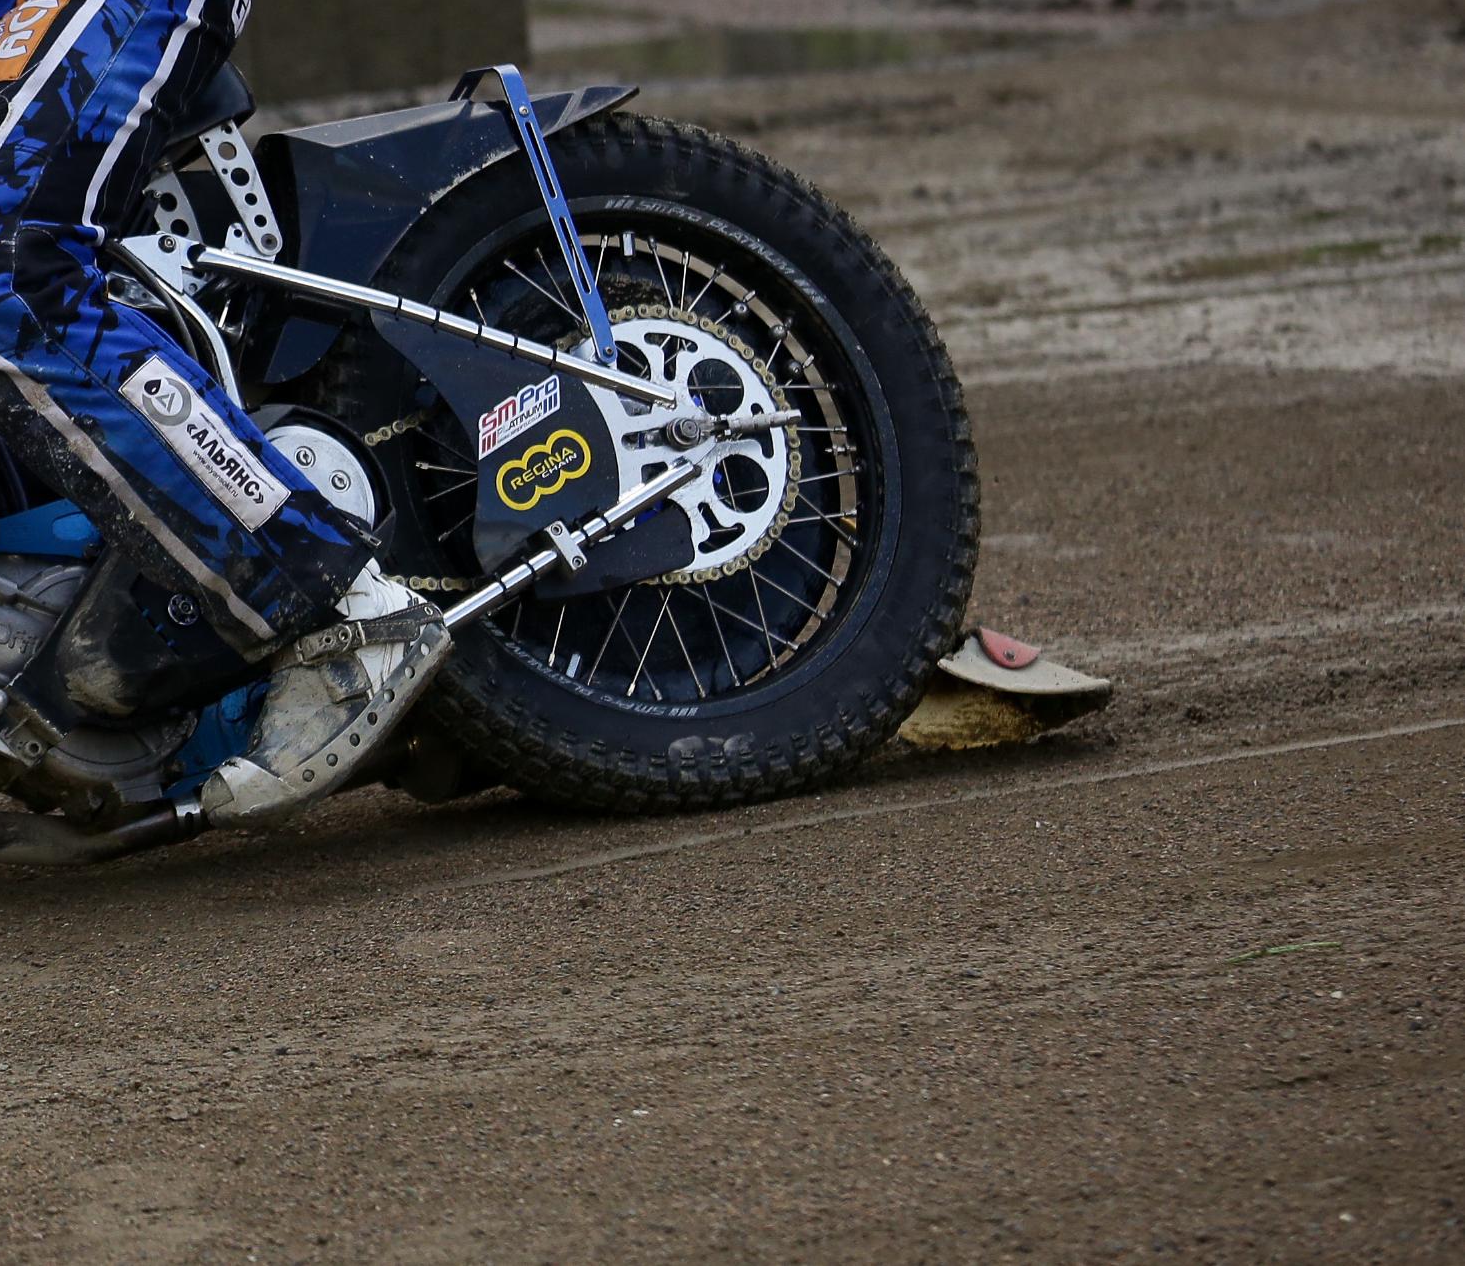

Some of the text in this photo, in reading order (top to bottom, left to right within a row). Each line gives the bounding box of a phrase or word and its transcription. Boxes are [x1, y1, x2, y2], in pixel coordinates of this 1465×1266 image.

[187, 424, 264, 504] «АЛЬЯНС»
[510, 446, 574, 490] REGINA
[541, 452, 577, 479] CHAIN
